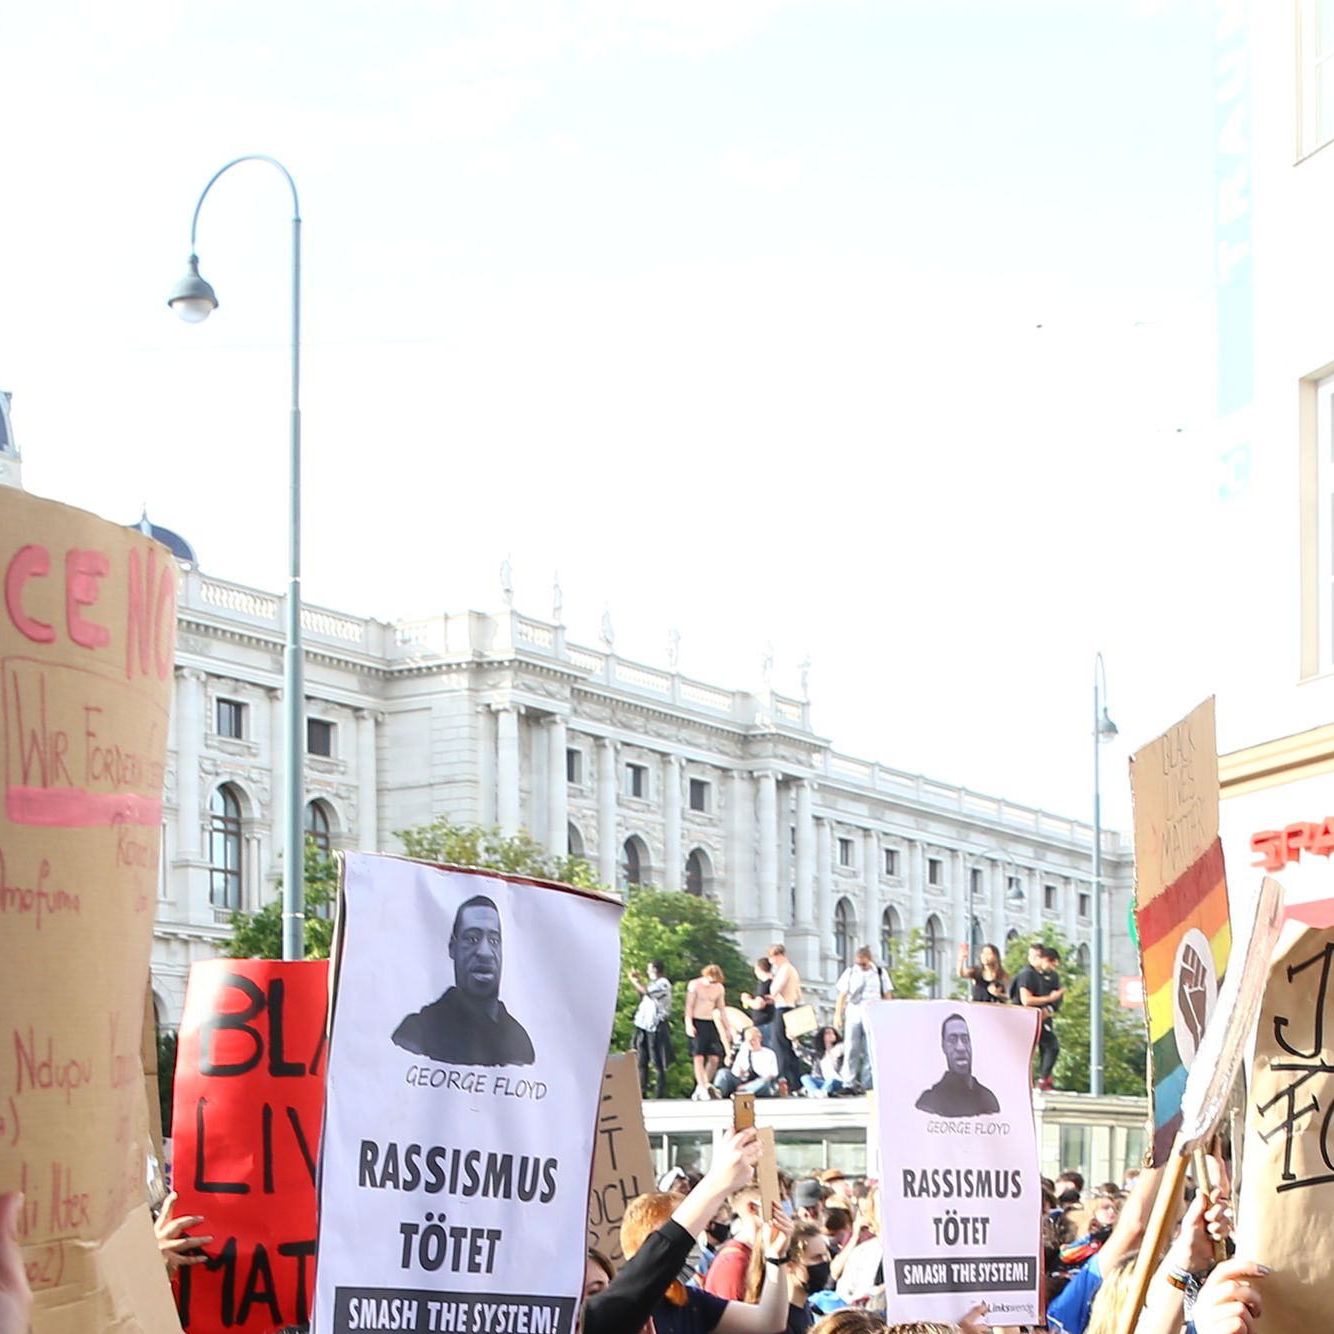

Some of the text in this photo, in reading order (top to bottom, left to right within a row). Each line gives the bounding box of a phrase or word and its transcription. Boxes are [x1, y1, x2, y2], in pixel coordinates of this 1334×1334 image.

[406, 1064, 548, 1101] GEORGE FLOYD
[926, 1120, 1011, 1137] GEORGE FLOYD
[358, 1139, 559, 1204] RASSISMUS
[902, 1168, 1022, 1199] RASSISMUS
[399, 1213, 502, 1274] TÖTET
[933, 1209, 990, 1247] TÖTET
[903, 1261, 1029, 1285] SMASH THE SYSTEM!
[348, 1298, 418, 1331] SMASH
[427, 1302, 468, 1333] THE
